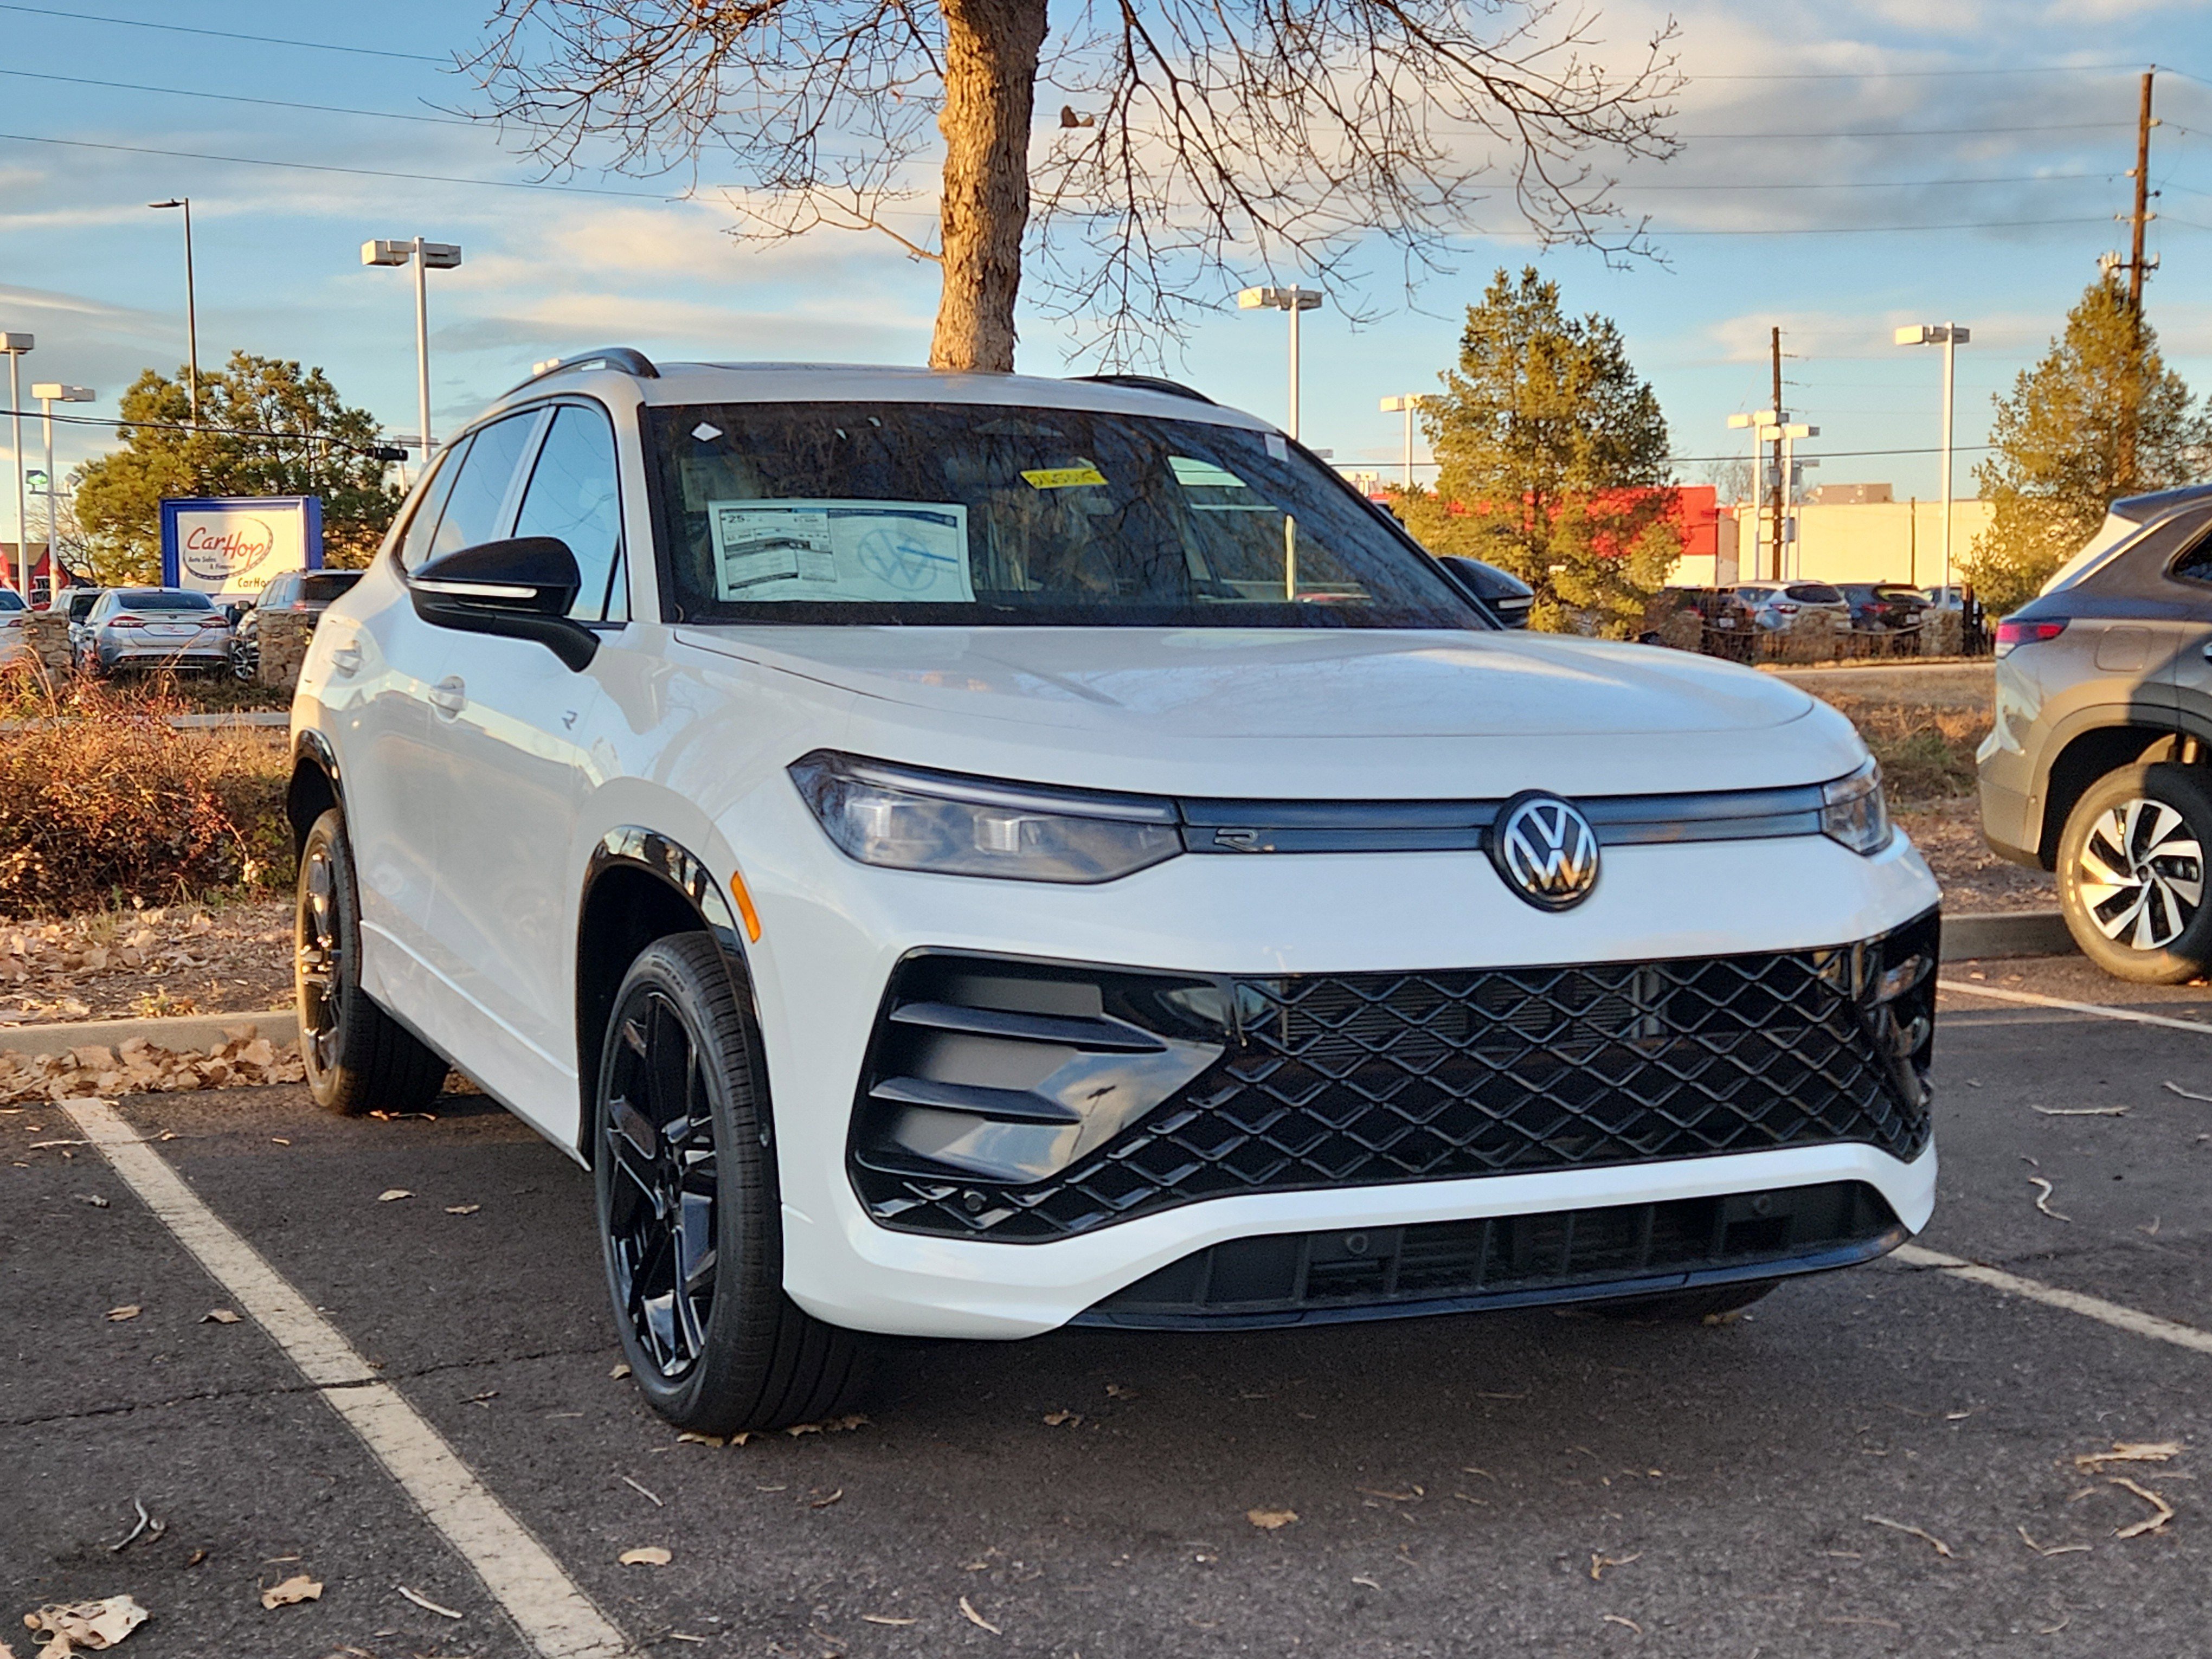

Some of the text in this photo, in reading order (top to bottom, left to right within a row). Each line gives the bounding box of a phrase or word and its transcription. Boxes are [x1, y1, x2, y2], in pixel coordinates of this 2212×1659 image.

[187, 526, 264, 568] CarHop
[238, 577, 271, 588] CarHo
[1503, 798, 1599, 902] VW
